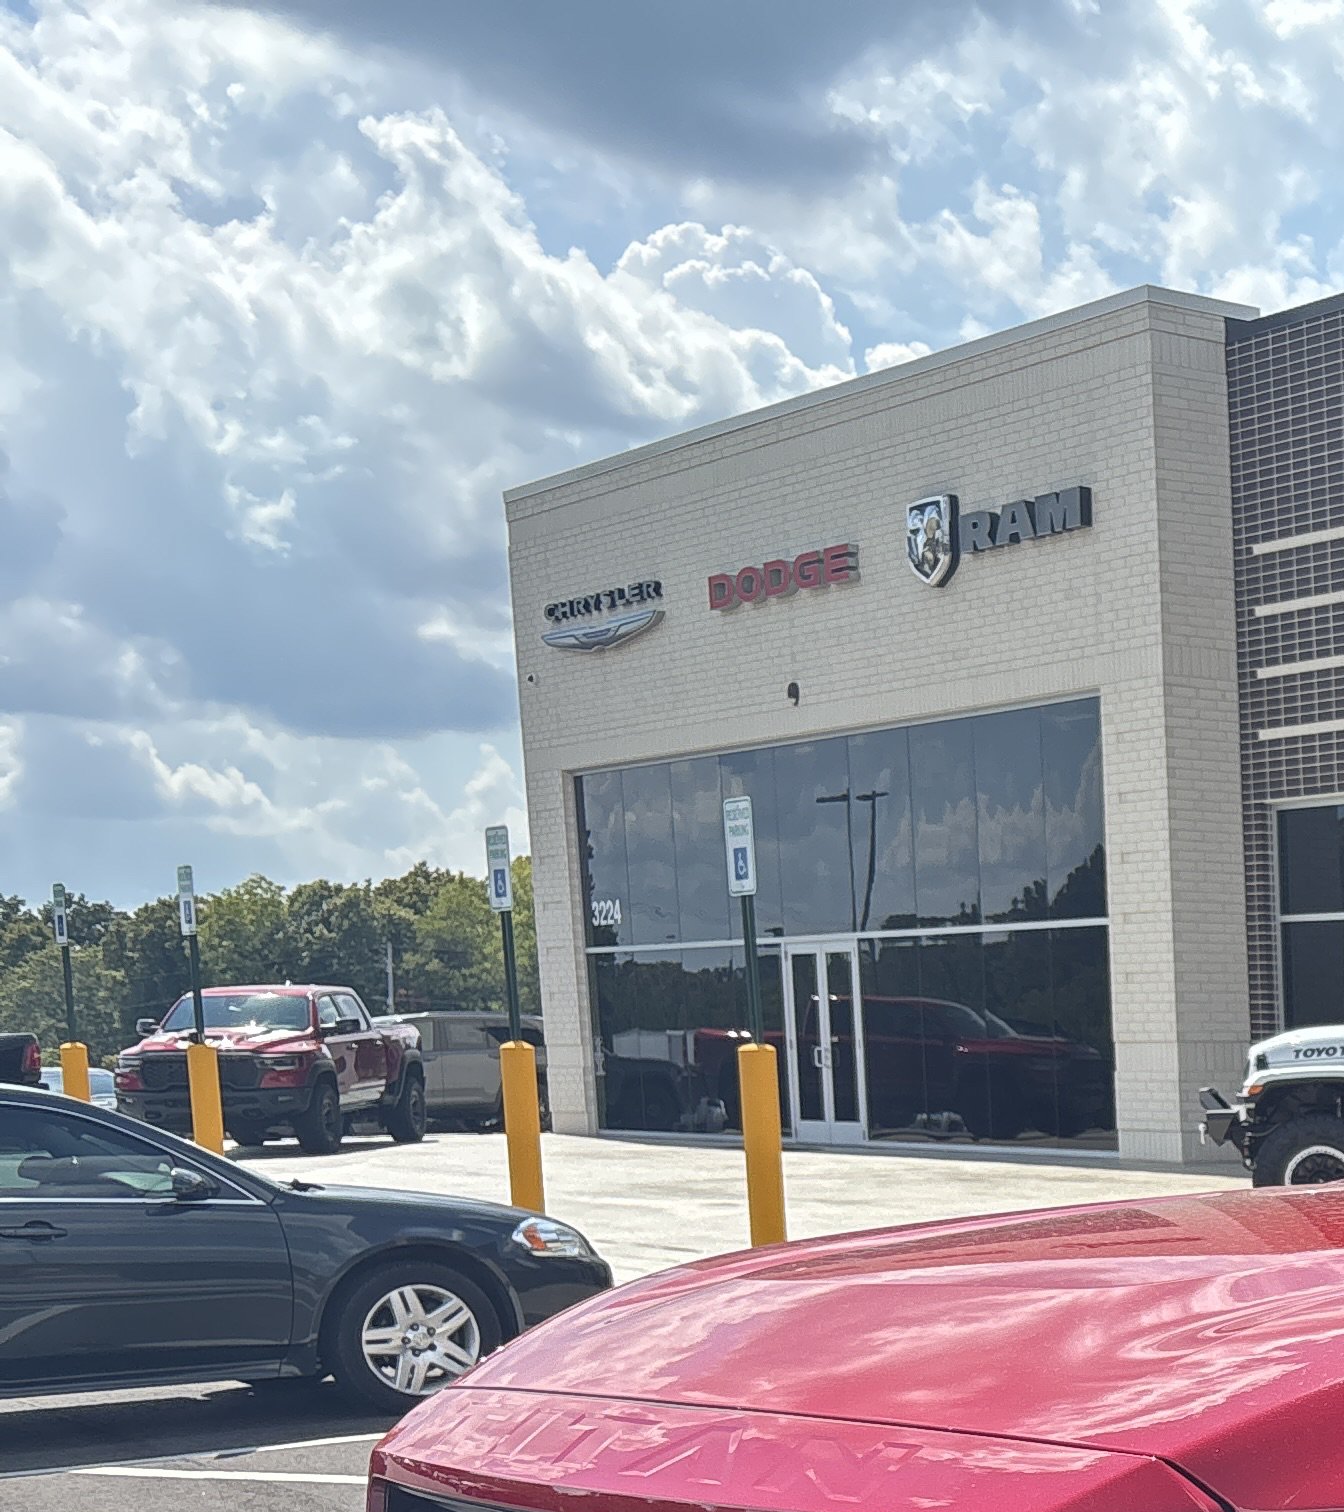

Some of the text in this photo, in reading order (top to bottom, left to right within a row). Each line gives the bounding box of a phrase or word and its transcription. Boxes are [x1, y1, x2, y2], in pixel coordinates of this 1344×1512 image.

[959, 486, 1090, 553] RAM
[707, 543, 858, 613] DODGE
[544, 580, 663, 622] CHRYSLER
[592, 899, 621, 926] 3224
[1294, 1047, 1339, 1059] TOYO
